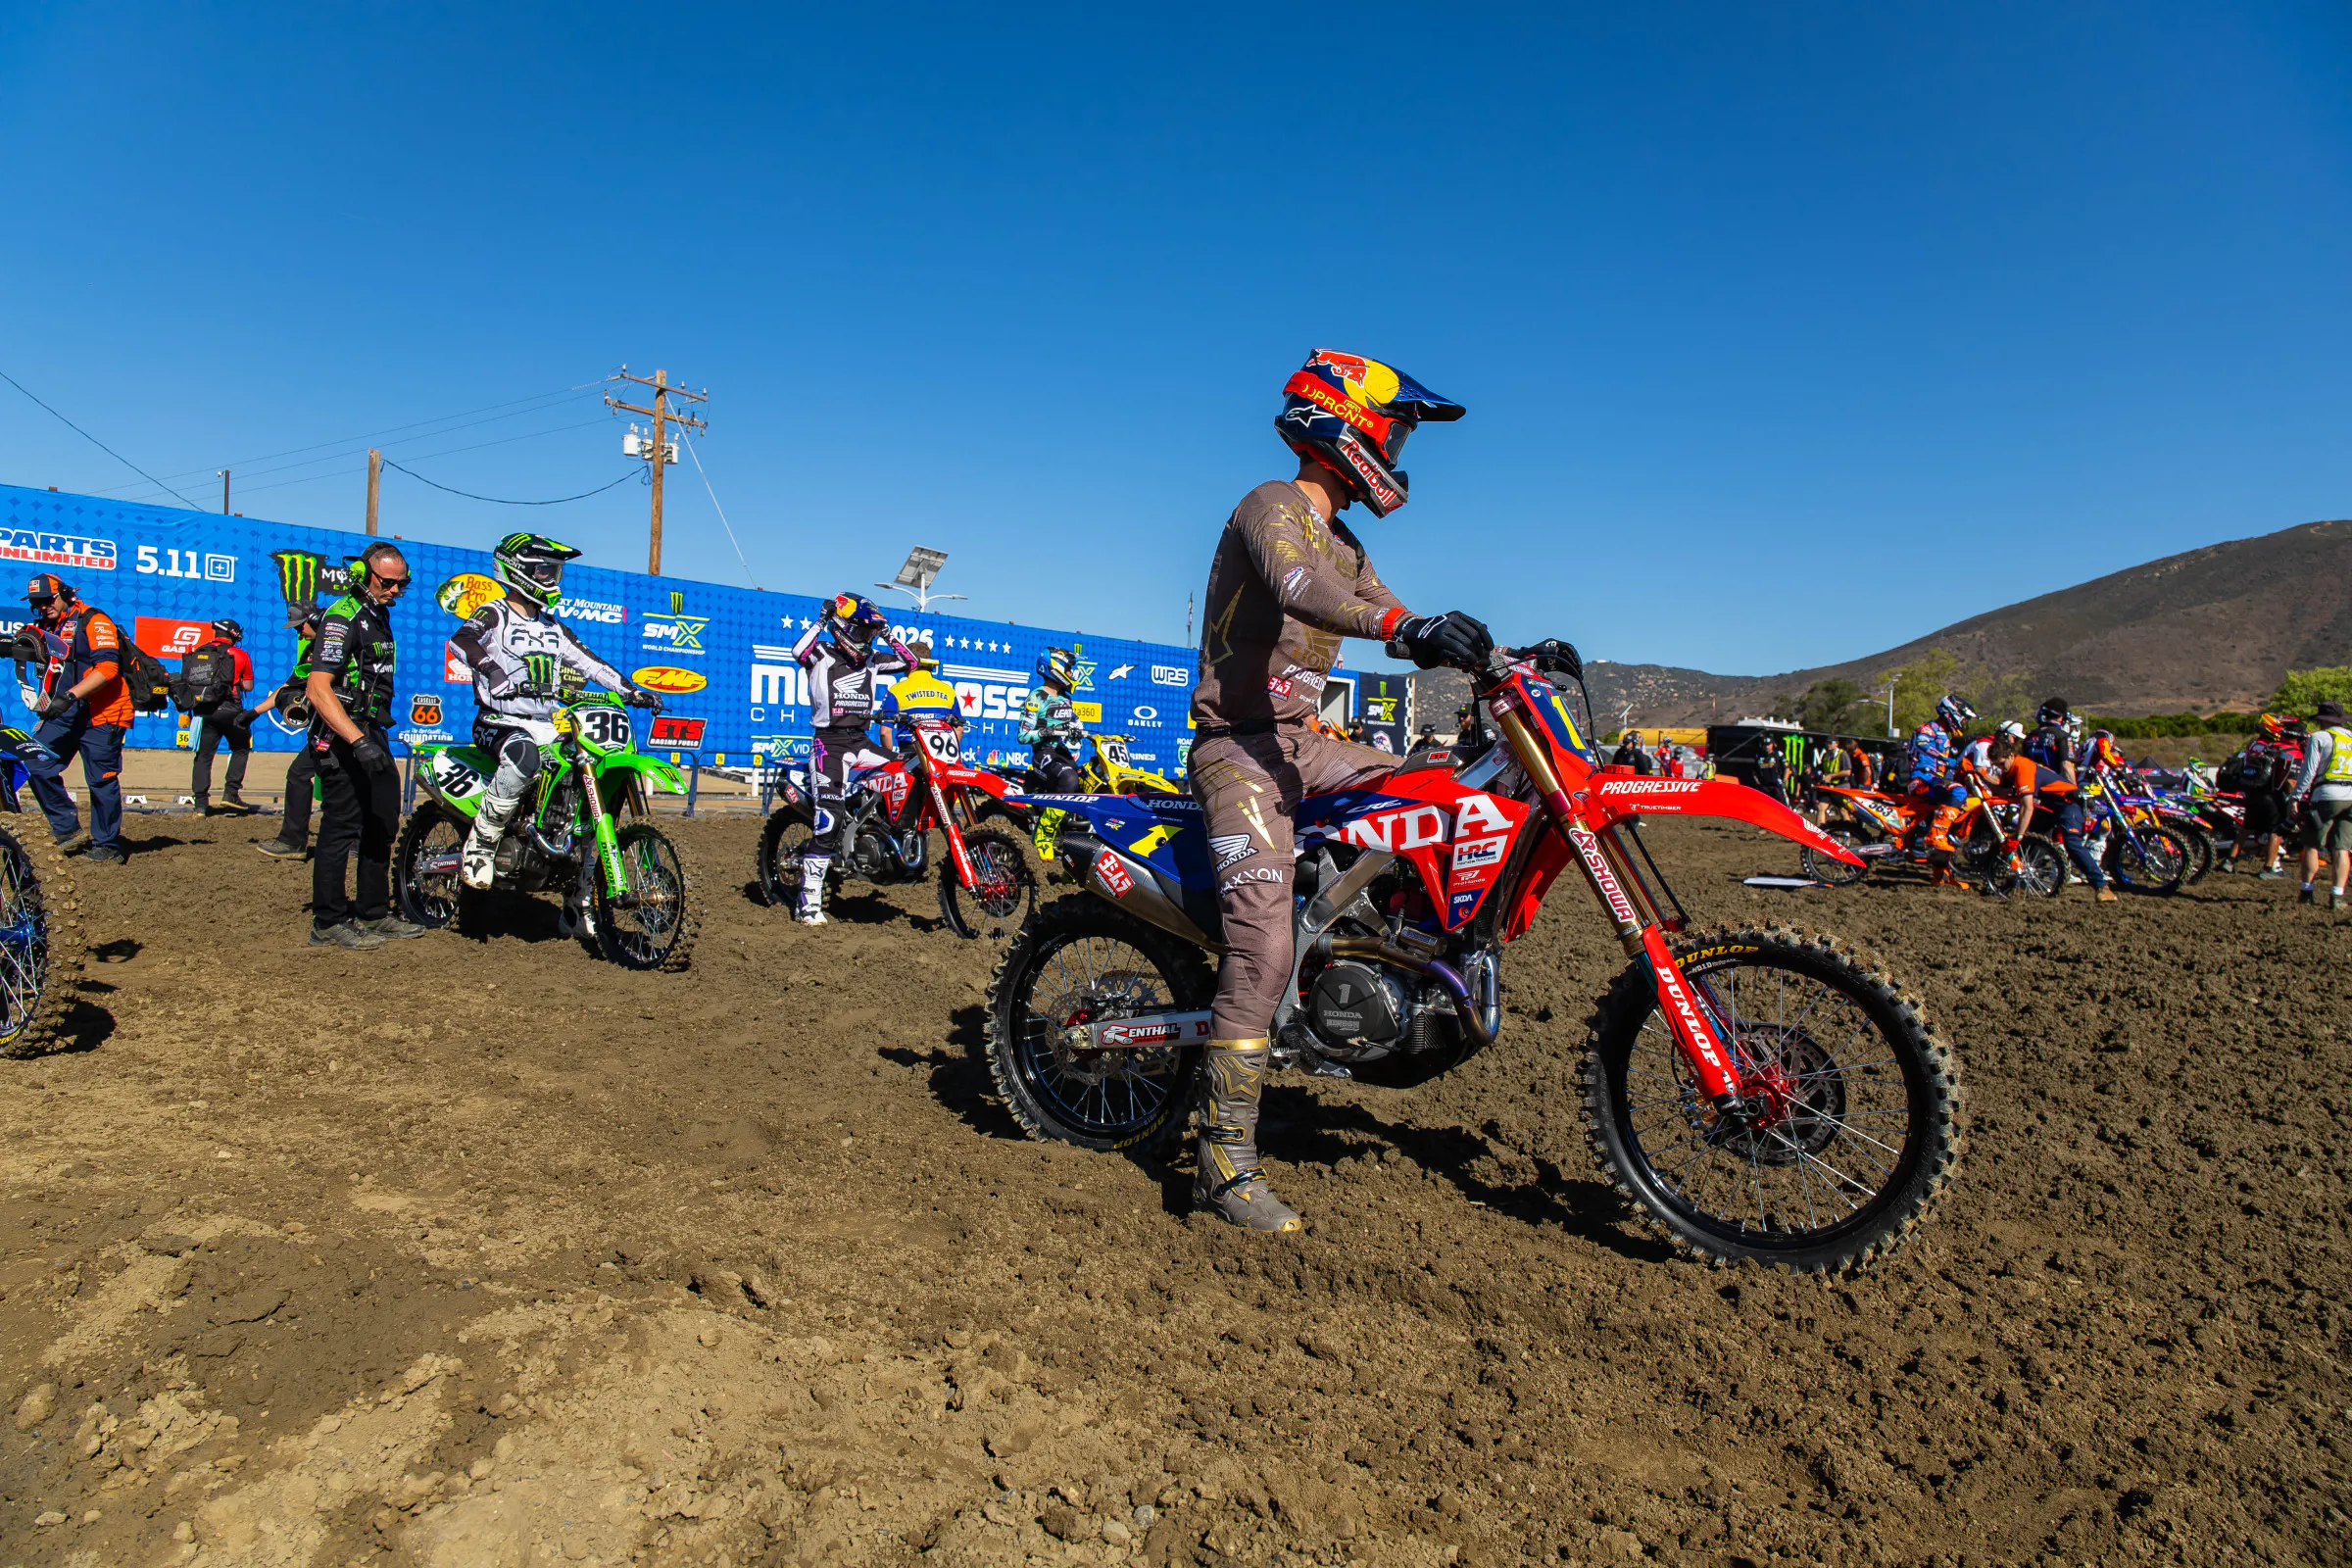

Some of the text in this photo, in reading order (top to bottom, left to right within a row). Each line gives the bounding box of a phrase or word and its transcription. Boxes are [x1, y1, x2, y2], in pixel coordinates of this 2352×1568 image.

[0, 546, 115, 567] NLIMITED
[136, 545, 202, 579] 5.11
[466, 576, 493, 591] Bass
[466, 589, 486, 603] Pro
[574, 599, 622, 612] MOUNTAIN
[511, 628, 560, 648] FXR
[642, 620, 705, 649] SMX
[663, 647, 706, 656] CHAMPIONSHIP
[633, 670, 707, 688] FMF
[1152, 666, 1188, 685] WPS
[834, 692, 870, 701] HONDA
[906, 690, 949, 702] TWISTED TEA
[414, 707, 438, 724] 66
[1367, 703, 1396, 721] SMX
[585, 711, 629, 744] 36
[652, 718, 705, 740] ETS
[1127, 719, 1162, 728] OAKLEY
[179, 733, 189, 742] 36
[398, 733, 454, 743] FOUNDATION
[930, 734, 958, 759] 96
[751, 739, 794, 758] SMX
[1109, 745, 1128, 762] 45
[1006, 753, 1029, 766] NBC
[436, 762, 480, 798] 36
[1599, 781, 1702, 796] PROGRESSIVE
[588, 787, 601, 820] SHOWA
[1032, 794, 1101, 804] DUNLOP
[1148, 799, 1203, 811] HOND
[1216, 847, 1258, 872] HONDA
[1457, 841, 1497, 861] HRC
[1588, 854, 1635, 922] SHOWA
[1453, 894, 1474, 905] SKDA
[1674, 945, 1759, 968] DUNLOP
[1338, 983, 1351, 1004] 1
[1323, 1009, 1363, 1019] HONDA
[1656, 966, 1720, 1067] DUNLOP
